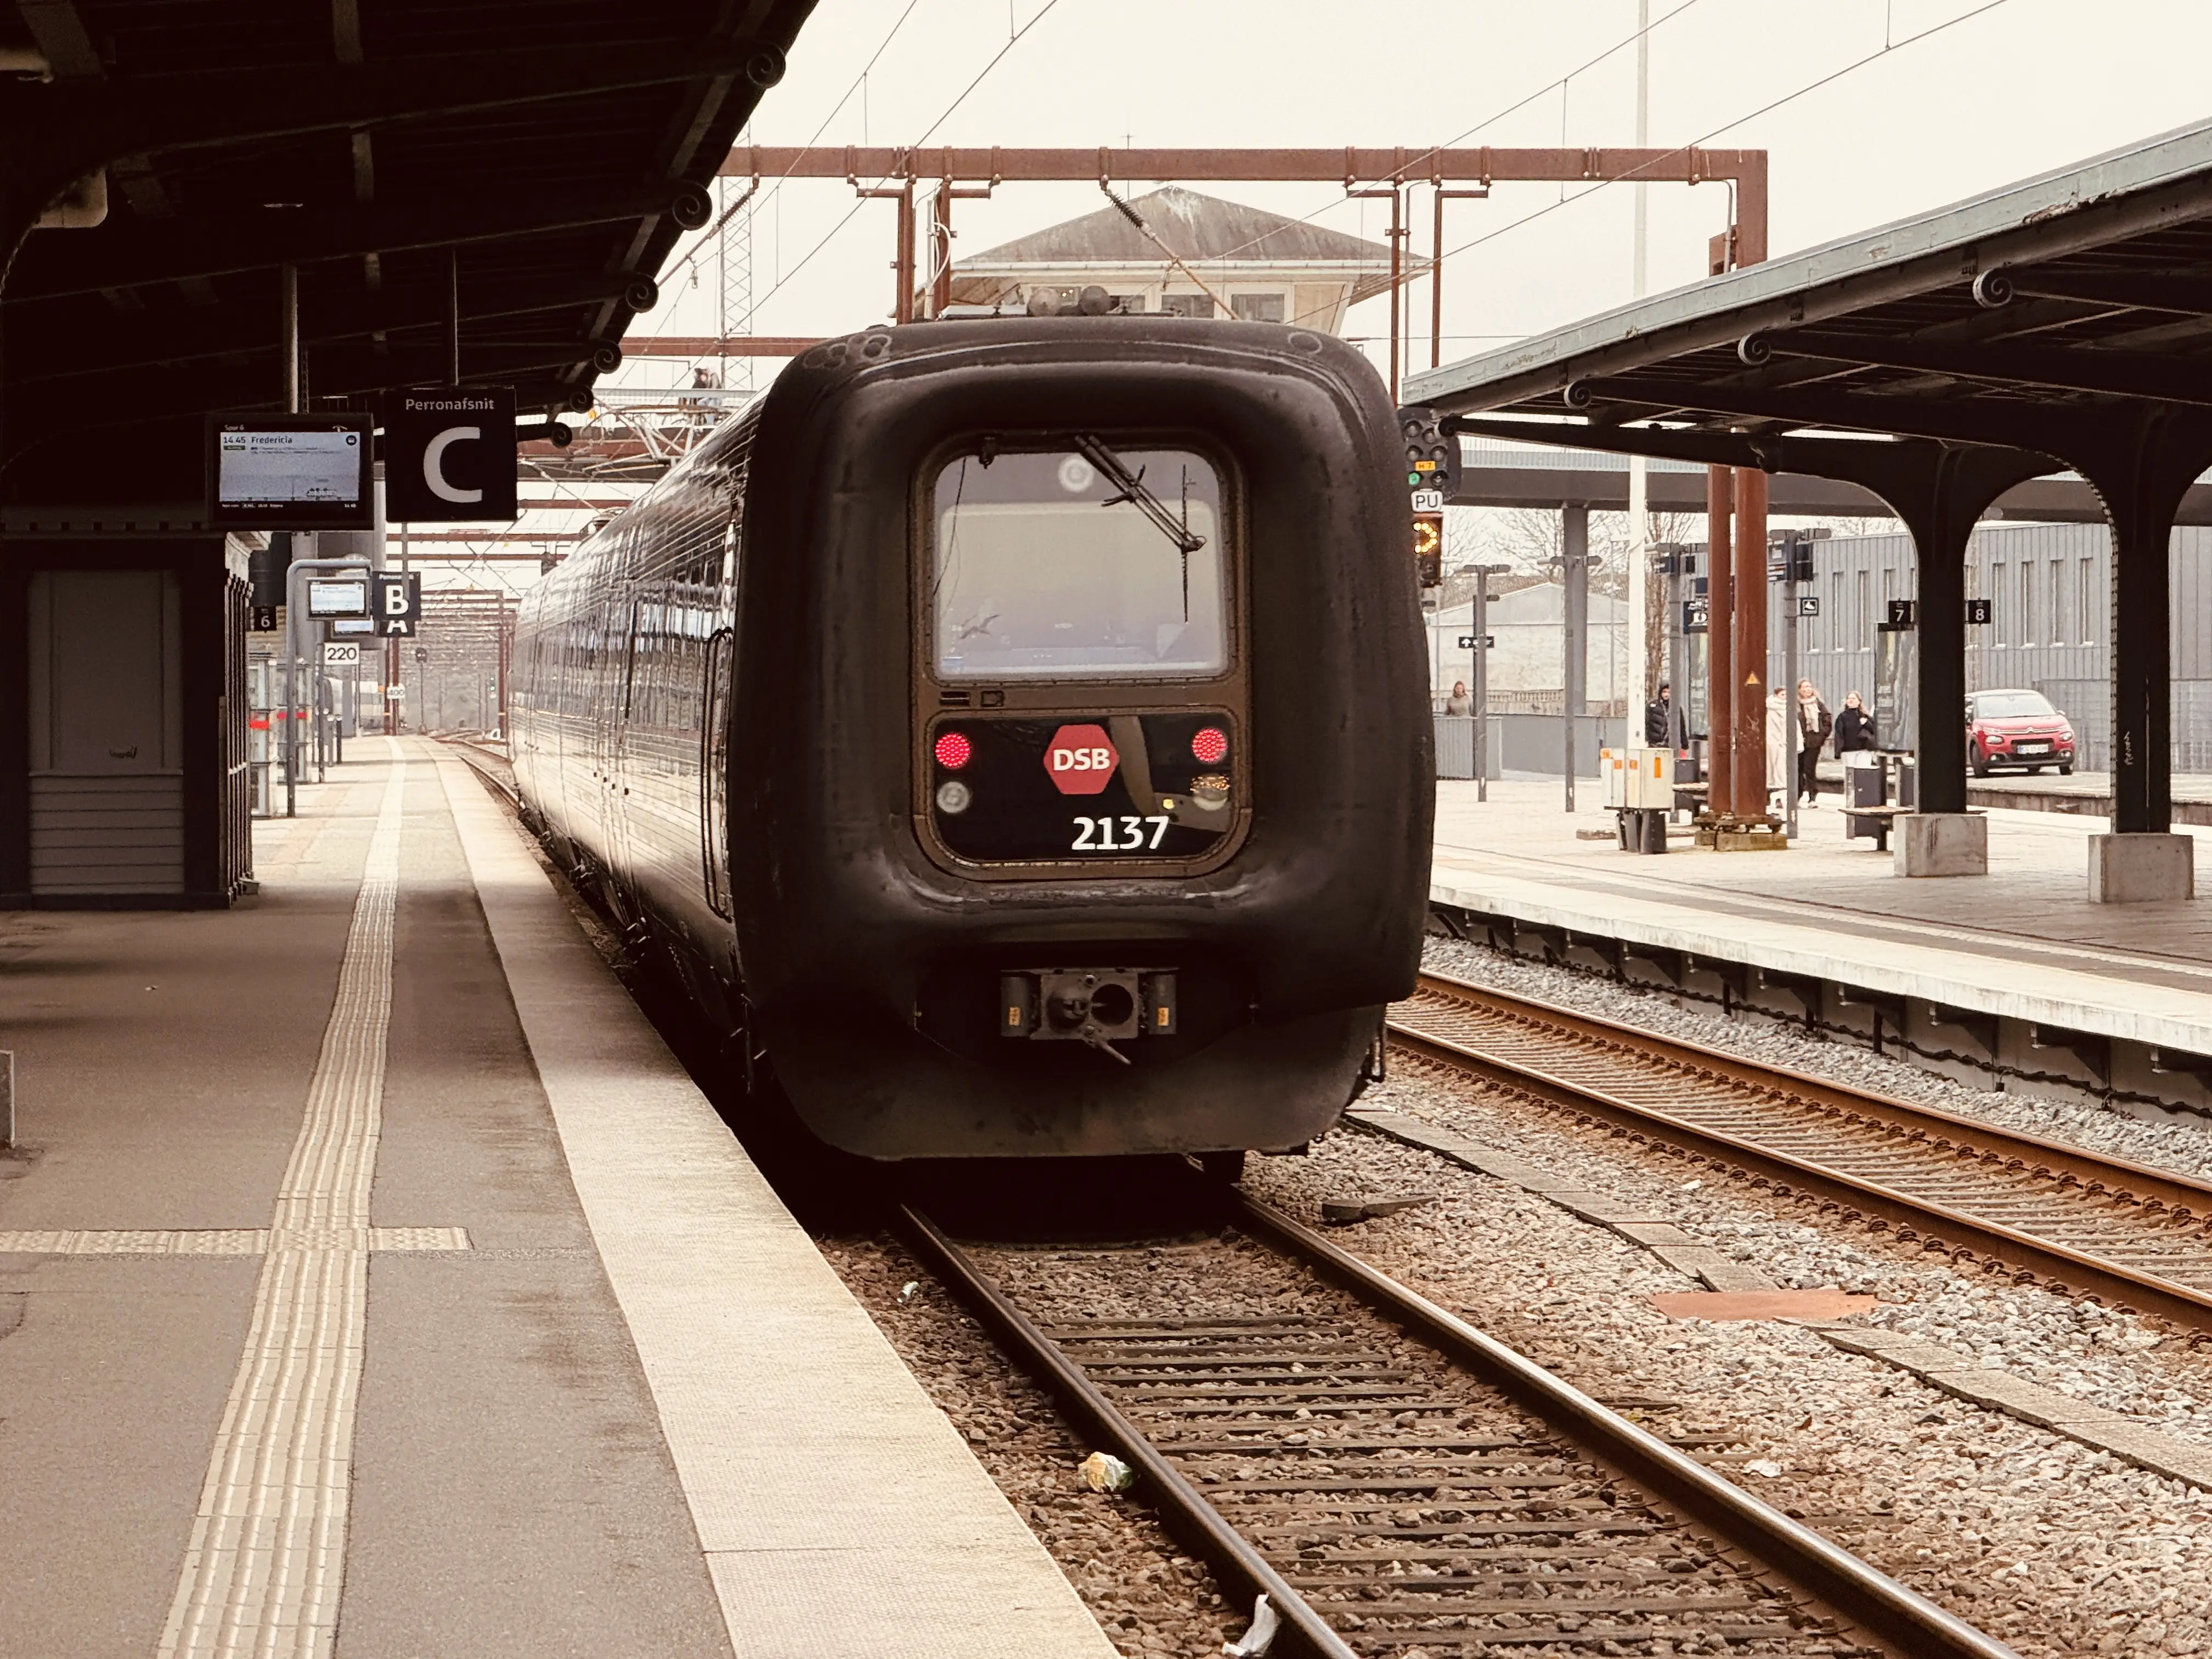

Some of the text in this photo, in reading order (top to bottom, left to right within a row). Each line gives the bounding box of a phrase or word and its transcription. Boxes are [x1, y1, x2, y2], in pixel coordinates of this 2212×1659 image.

[405, 398, 494, 410] Perronafsnit
[424, 427, 482, 503] C
[1415, 495, 1438, 508] PU
[386, 585, 409, 614] B
[1895, 610, 1904, 622] 7
[1976, 609, 1985, 621] 8
[261, 616, 270, 628] 6
[327, 647, 357, 660] 220
[1053, 748, 1110, 770] DSB
[1071, 816, 1169, 850] 2137
